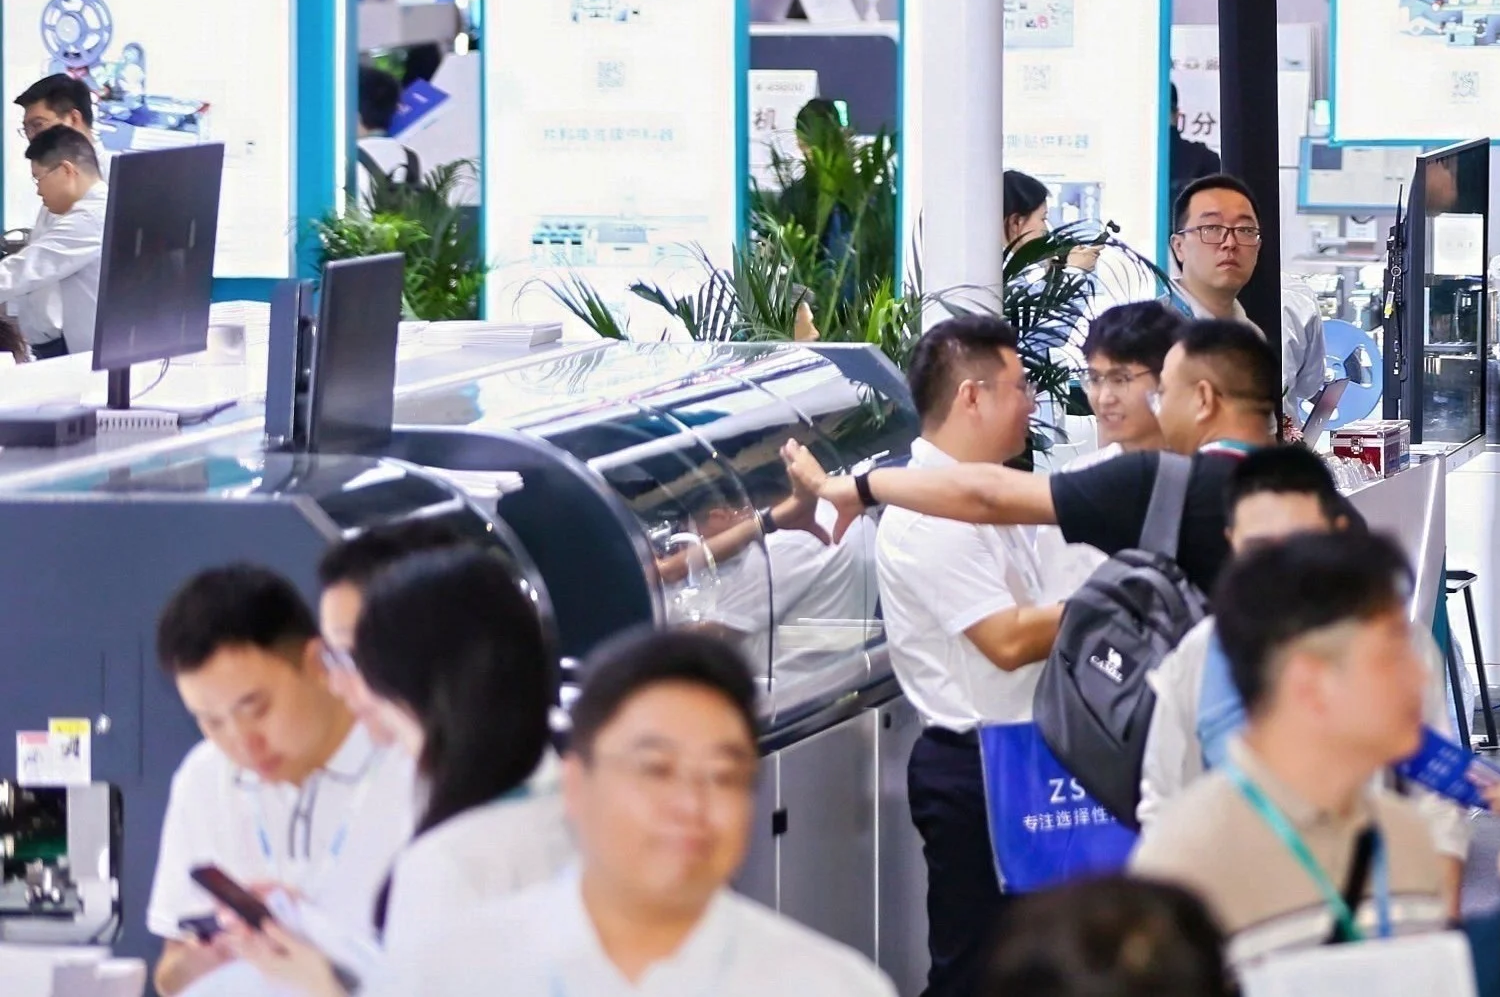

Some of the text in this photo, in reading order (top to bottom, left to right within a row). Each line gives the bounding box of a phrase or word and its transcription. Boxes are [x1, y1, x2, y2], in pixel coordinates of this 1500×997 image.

[1090, 655, 1124, 684] CAMEL
[1049, 777, 1087, 804] ZS
[1023, 805, 1118, 833] 专注选择性
